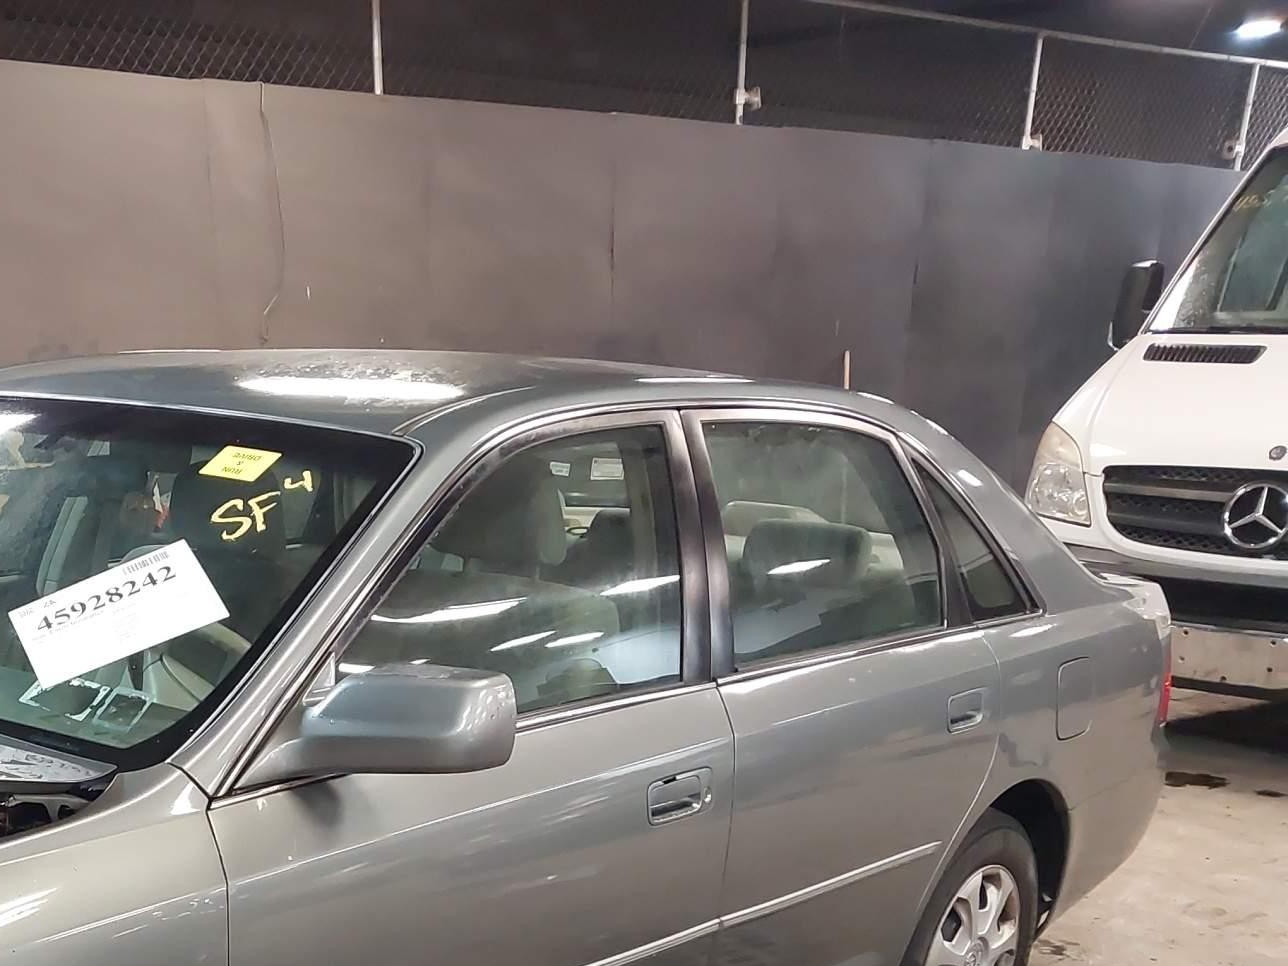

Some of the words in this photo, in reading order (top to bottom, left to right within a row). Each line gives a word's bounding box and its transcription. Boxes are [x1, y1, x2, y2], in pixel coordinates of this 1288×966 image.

[222, 466, 243, 475] RUN
[210, 491, 281, 540] SF
[37, 566, 177, 631] 45928242
